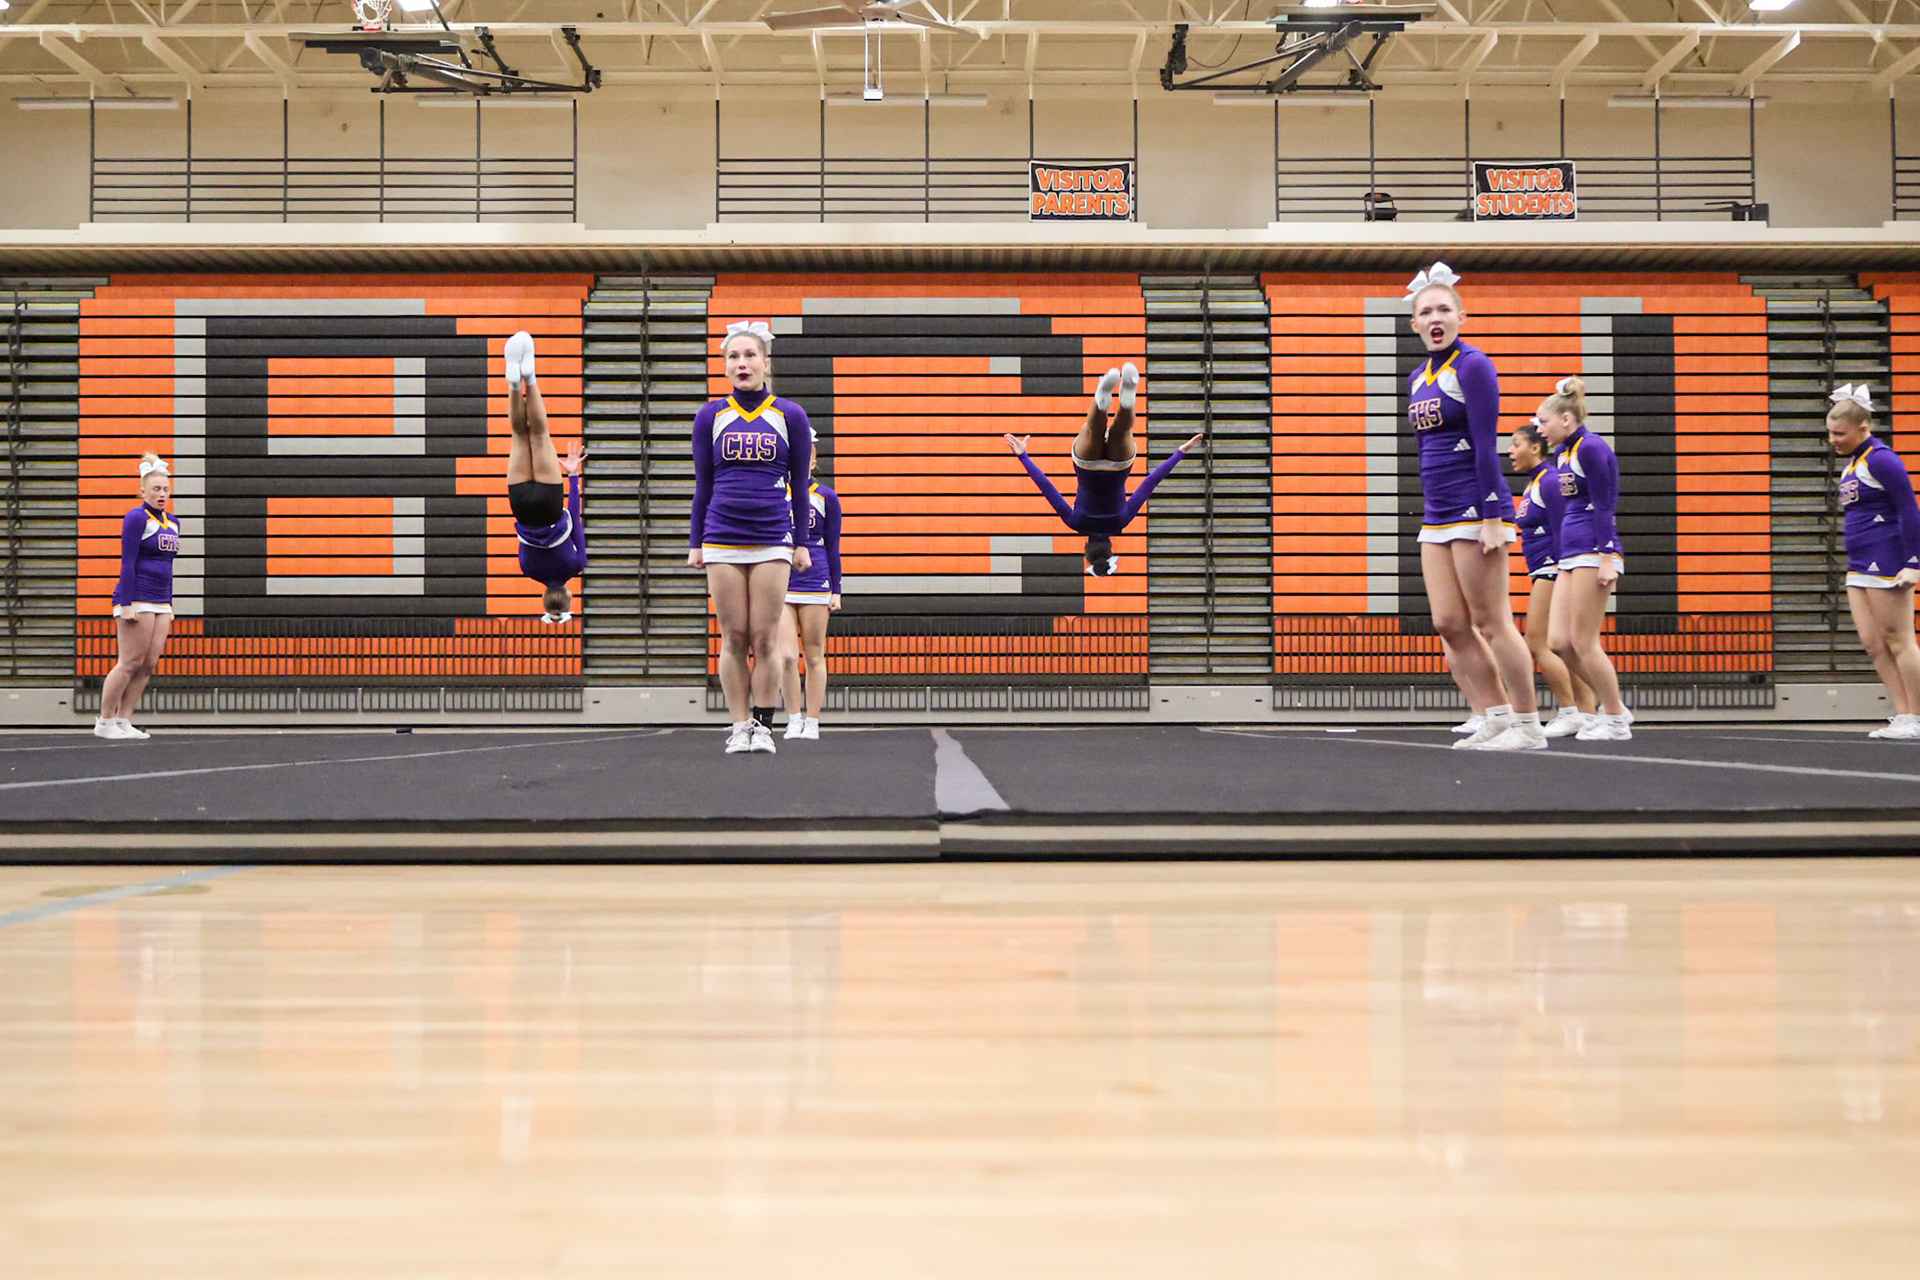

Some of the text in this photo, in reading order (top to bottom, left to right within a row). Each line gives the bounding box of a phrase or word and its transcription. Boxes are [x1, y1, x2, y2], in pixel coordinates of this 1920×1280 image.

[1036, 168, 1125, 191] VISITOR
[1486, 168, 1564, 191] VISITOR
[1032, 192, 1130, 215] PARENTS
[1477, 191, 1575, 215] STUDENTS
[721, 431, 777, 462] CHS
